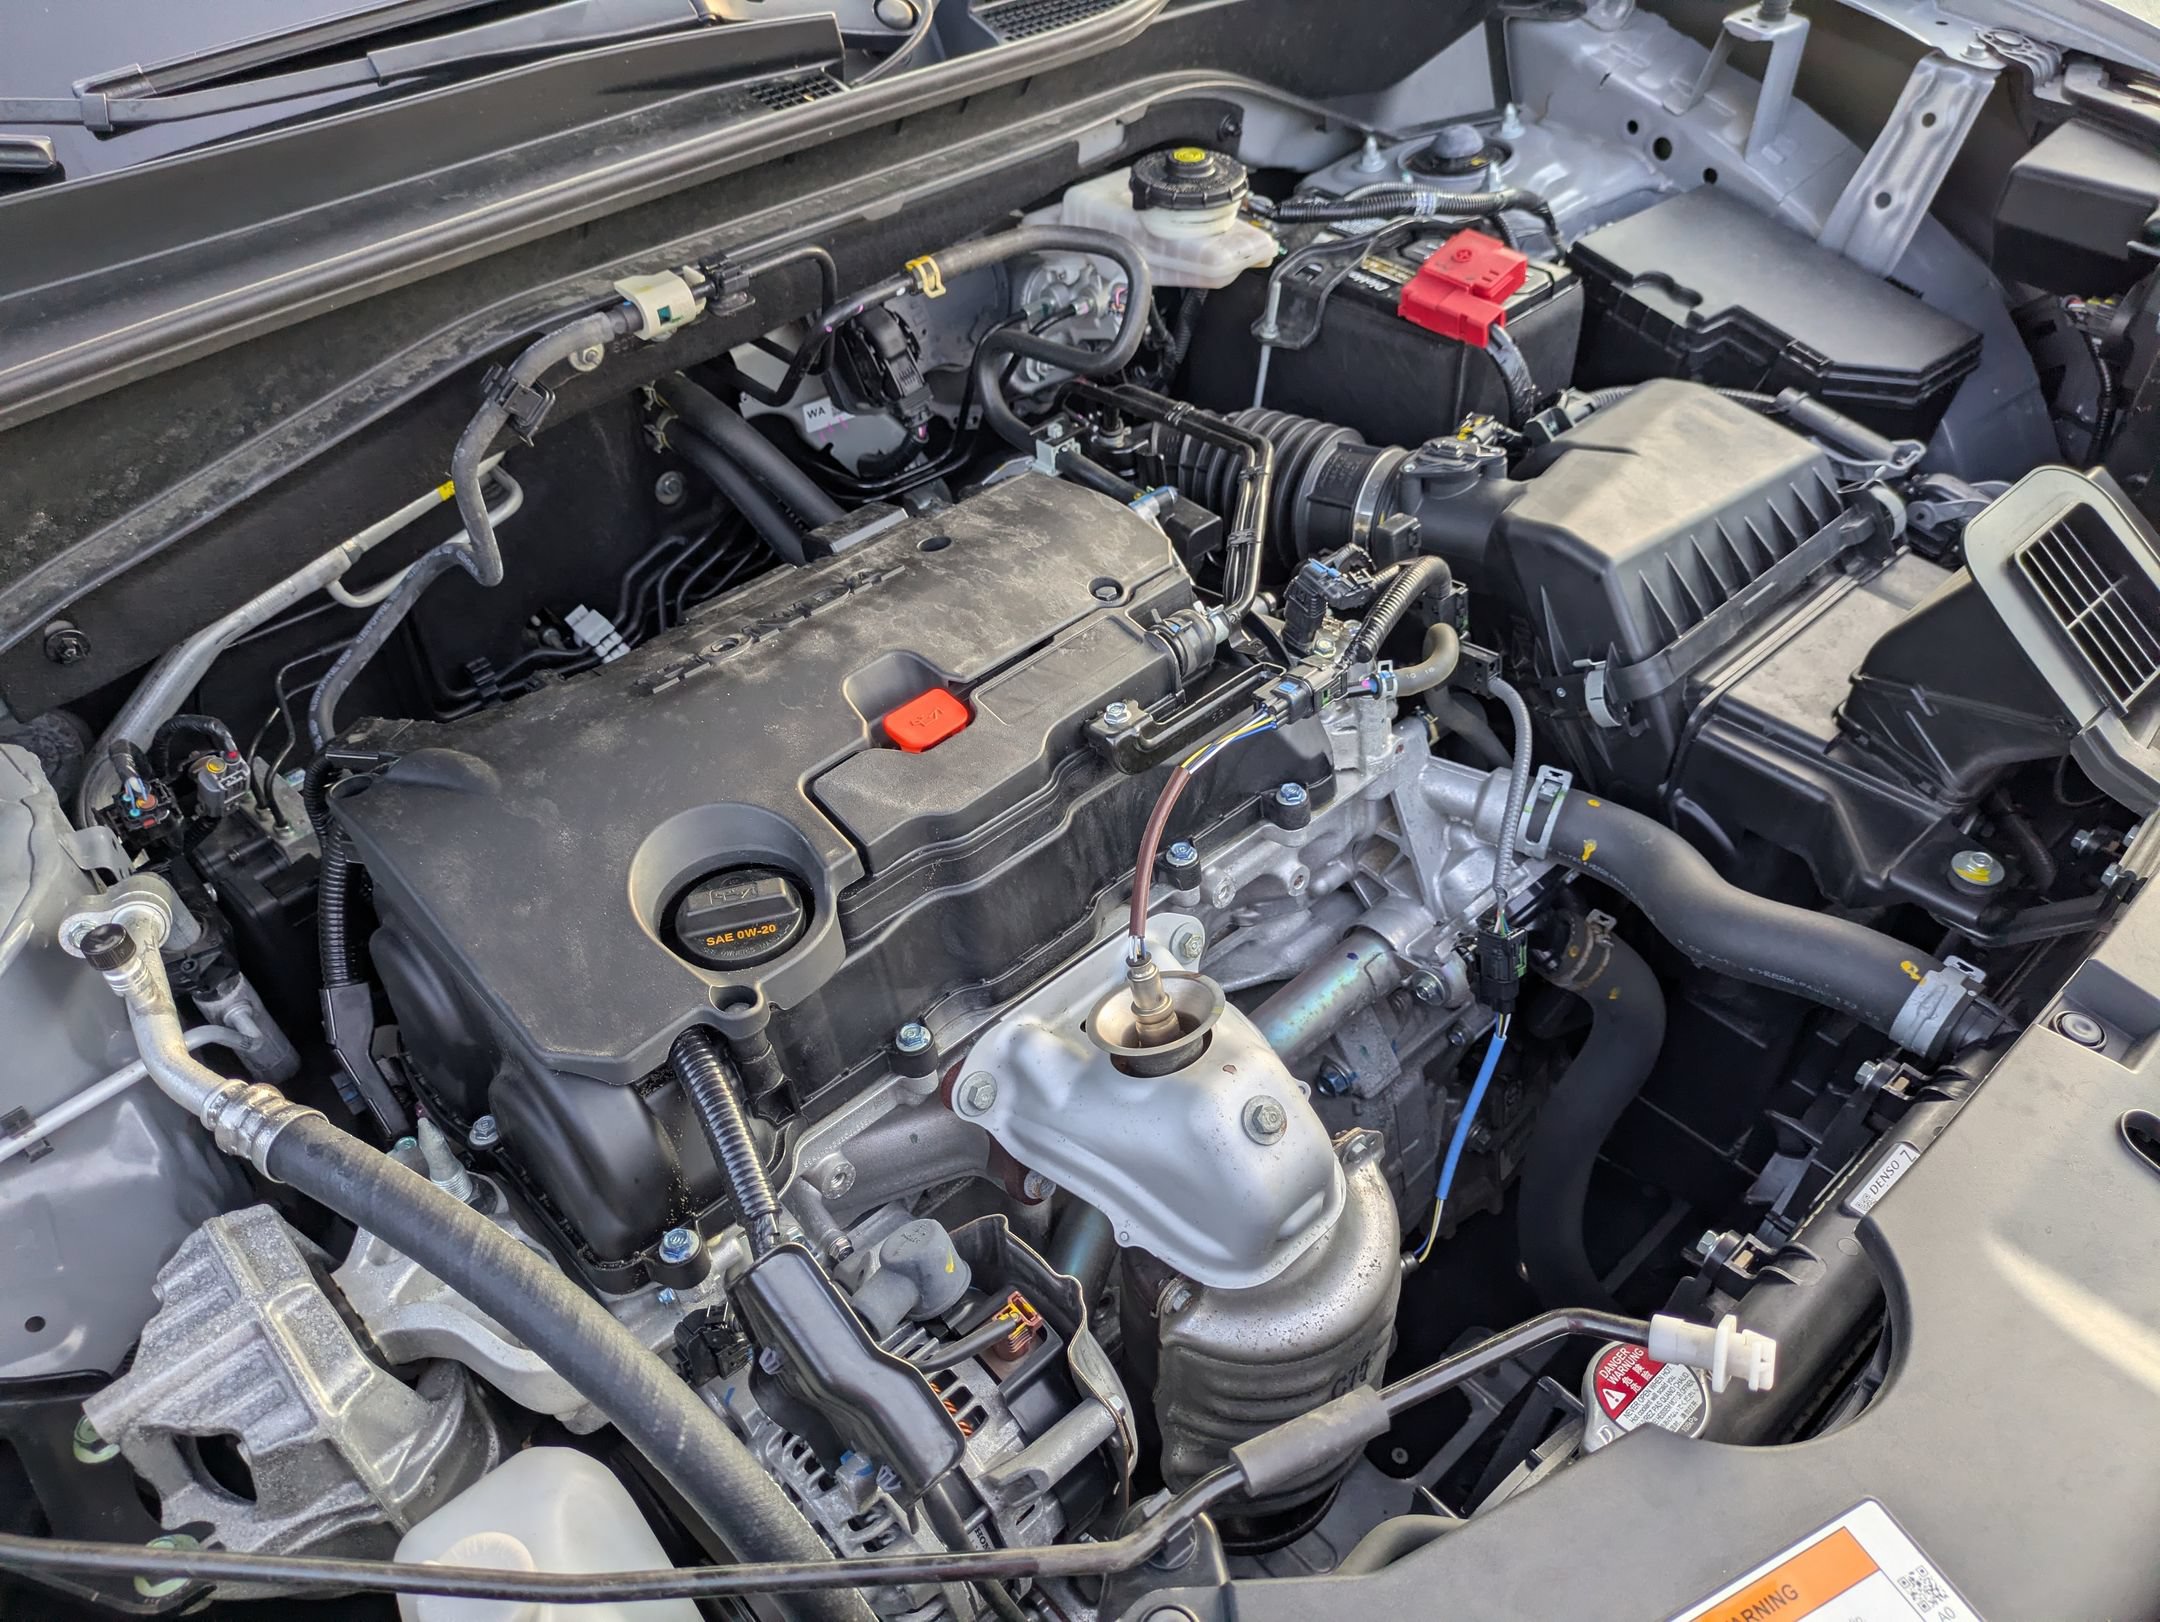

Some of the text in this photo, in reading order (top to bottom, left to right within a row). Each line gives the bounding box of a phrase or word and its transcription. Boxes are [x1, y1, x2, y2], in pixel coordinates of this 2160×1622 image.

[806, 406, 826, 419] WA
[706, 924, 777, 947] SAE 0W-20
[1869, 1160, 1900, 1195] DENSO
[1599, 1347, 1630, 1379] DANGER
[1606, 1348, 1644, 1385] WARNUNG
[1623, 1402, 1639, 1418] NEVER
[1638, 1388, 1652, 1404] OPEN
[1648, 1376, 1664, 1390] WHEN
[1629, 1413, 1640, 1424] Hot
[1638, 1399, 1653, 1416] coolant
[1650, 1392, 1659, 1401] will
[1656, 1382, 1669, 1395] scald
[1651, 1401, 1663, 1413] PAS
[1660, 1386, 1677, 1403] QUAND
[1673, 1371, 1689, 1389] CHAUD
